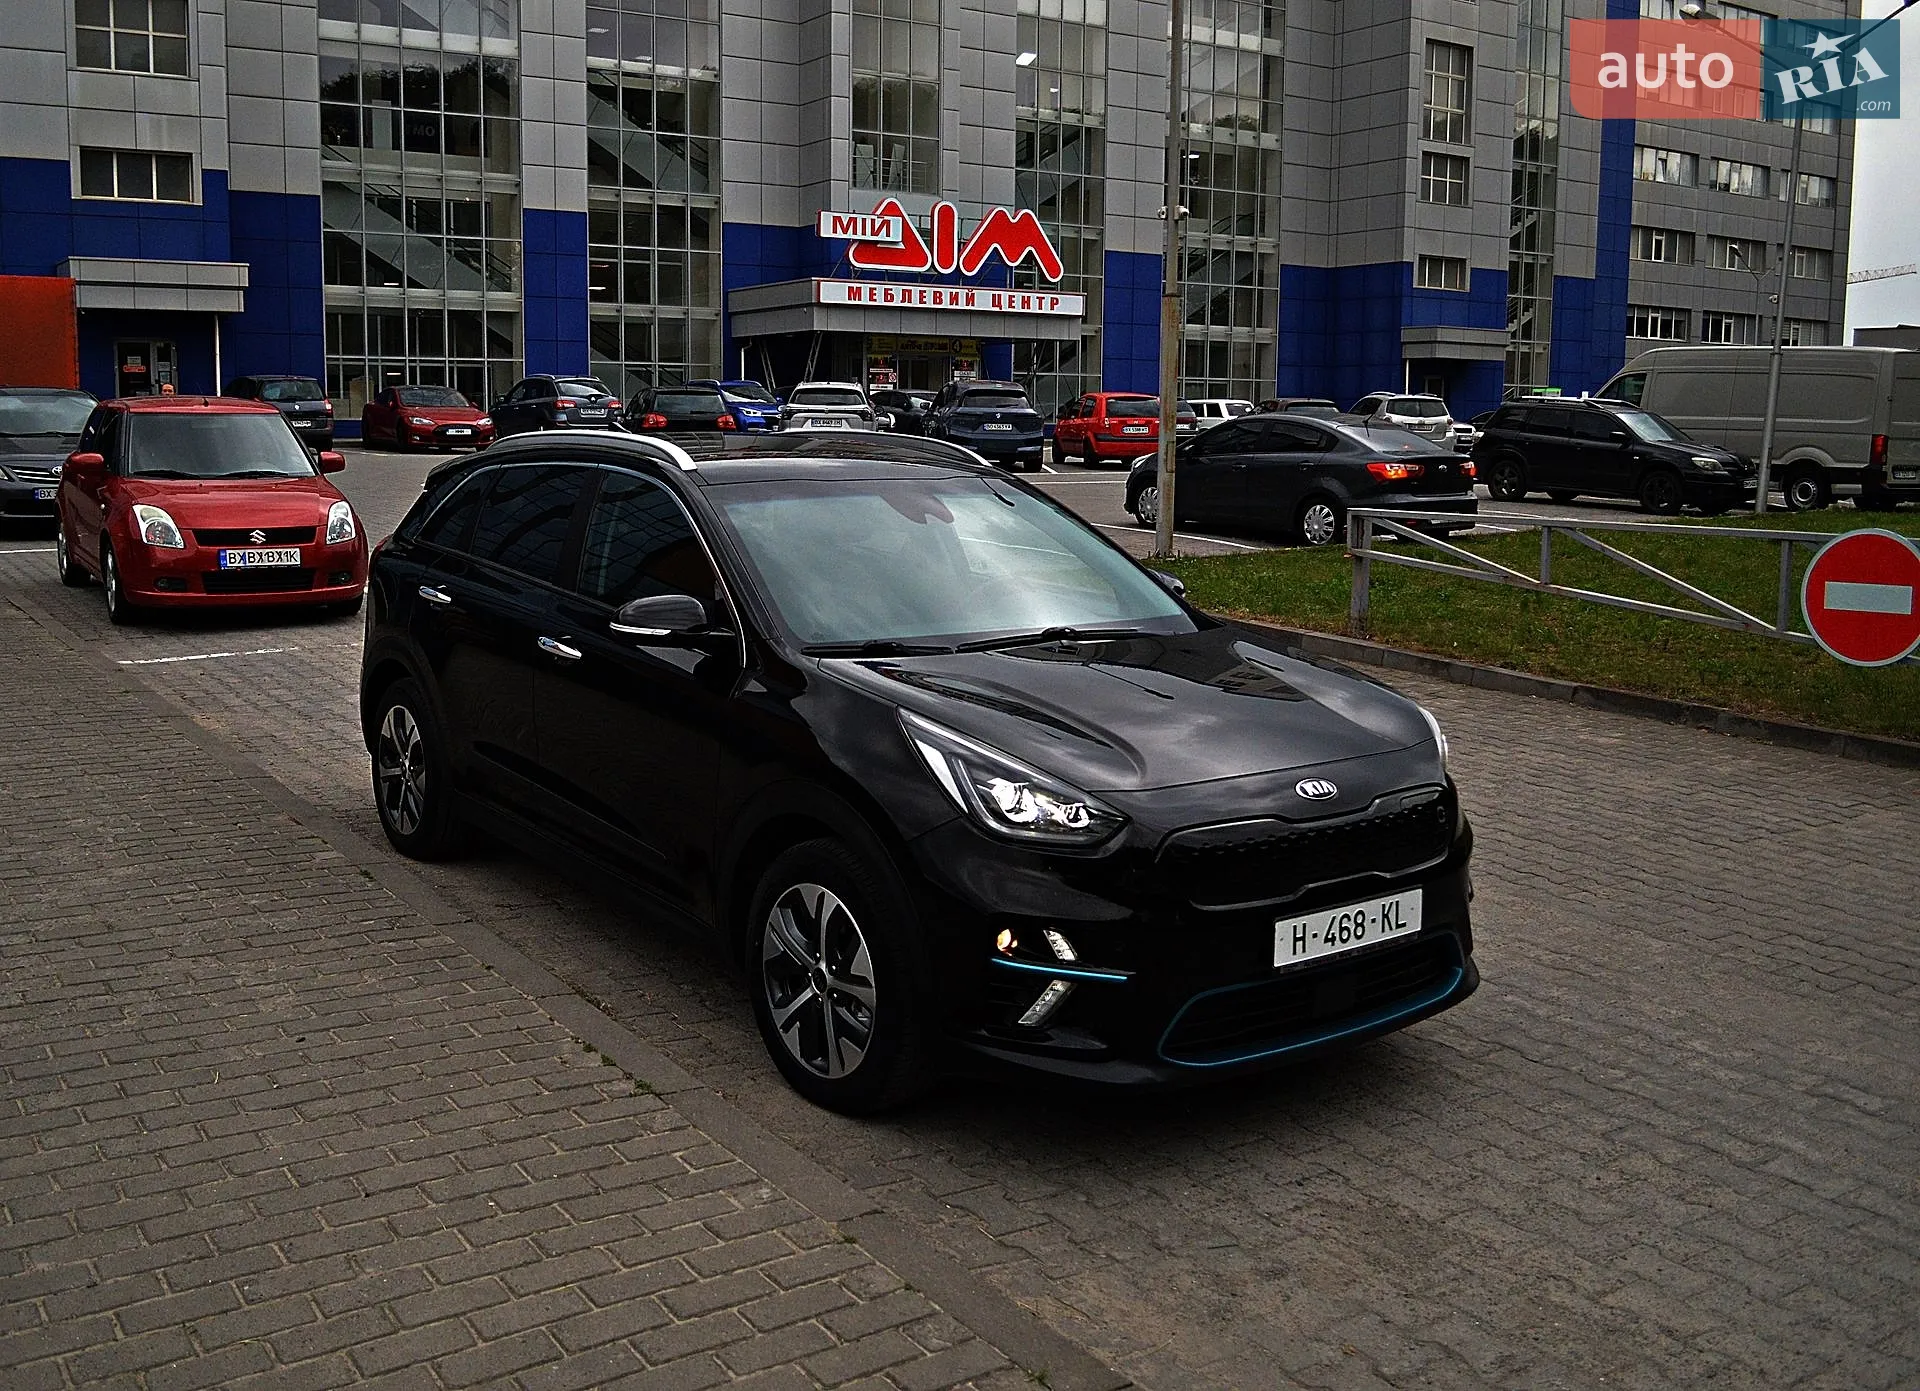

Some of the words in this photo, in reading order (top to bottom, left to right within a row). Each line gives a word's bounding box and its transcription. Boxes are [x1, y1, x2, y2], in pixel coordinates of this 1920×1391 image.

[831, 215, 891, 238] МІЙ
[847, 285, 976, 307] МЕБЛЕВИЙ
[991, 293, 1060, 311] ЦЕНТР
[1300, 780, 1335, 796] KIA
